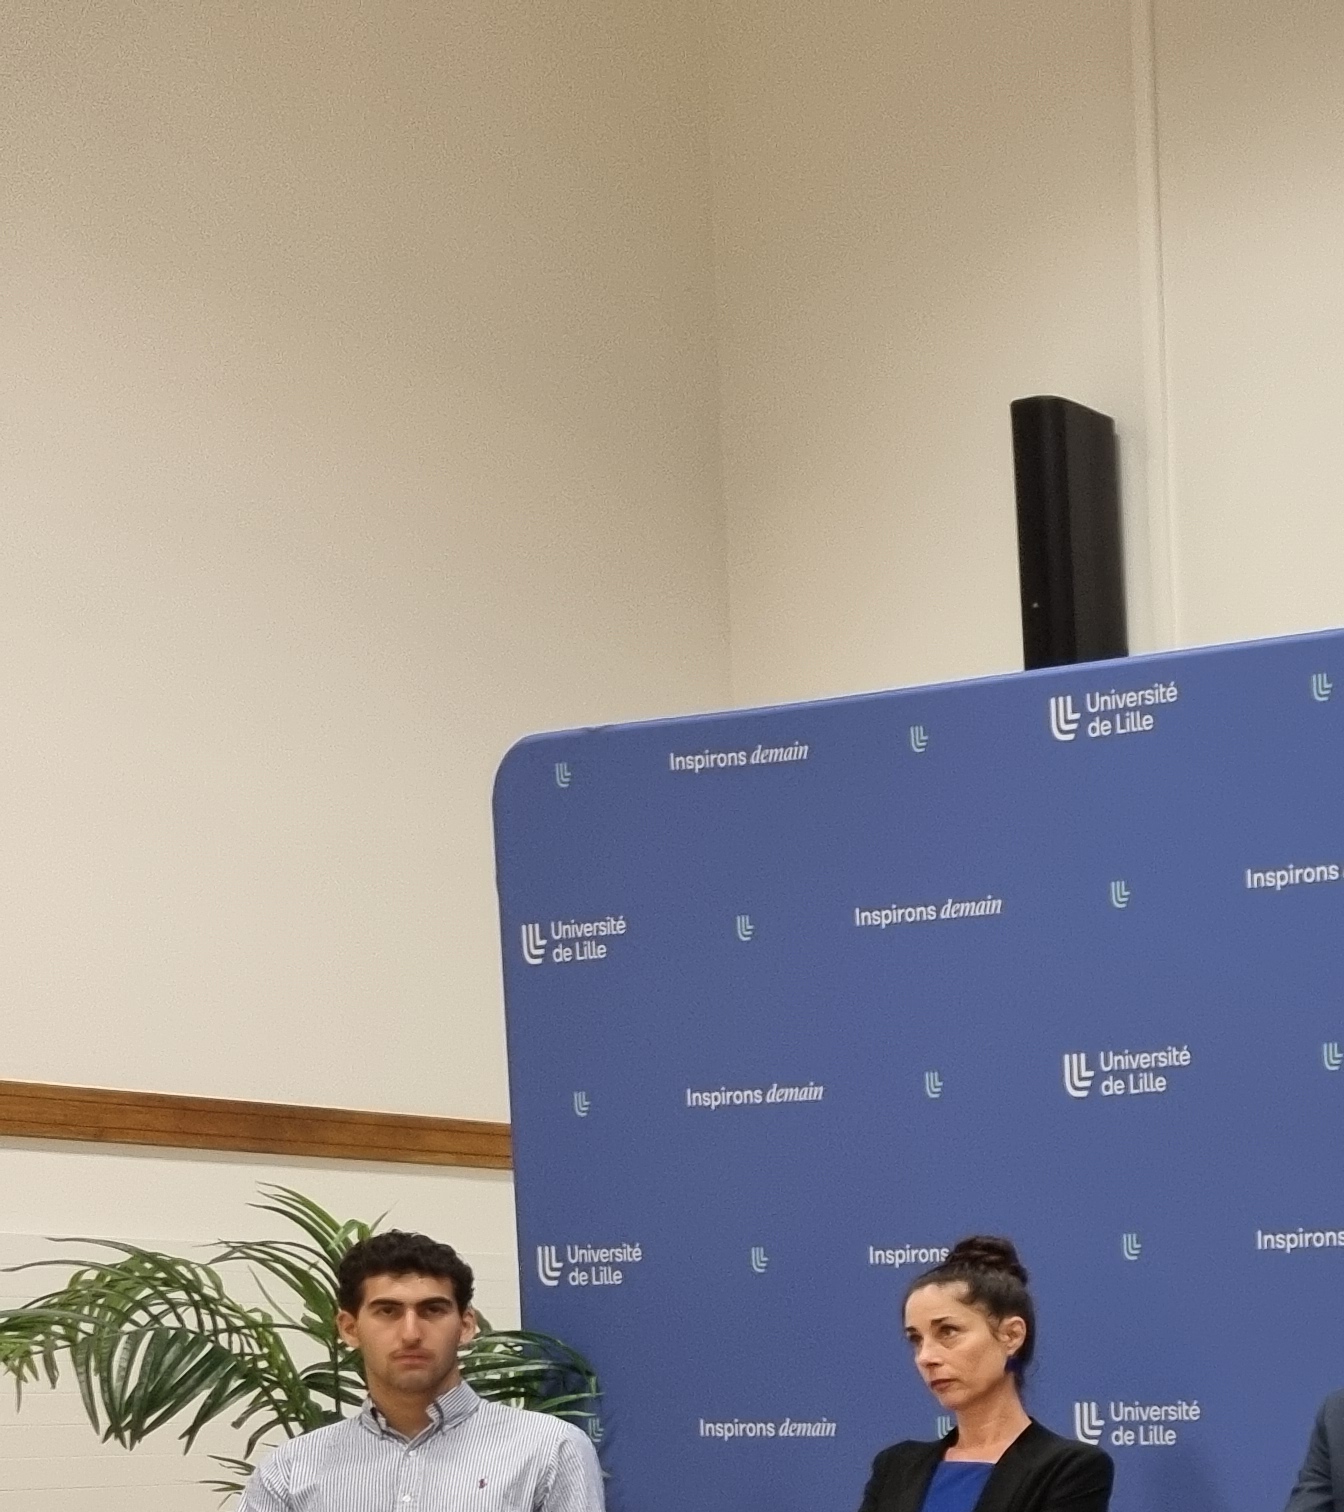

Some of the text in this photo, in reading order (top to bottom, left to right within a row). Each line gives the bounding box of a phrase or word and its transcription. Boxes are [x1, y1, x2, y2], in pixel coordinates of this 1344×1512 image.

[1085, 680, 1179, 713] Université
[1087, 710, 1154, 738] de Lille
[669, 740, 809, 774] Inspirons demain
[1245, 863, 1340, 891] Inspirons
[854, 894, 1003, 930] Inspirons demain
[550, 915, 627, 941] Université
[551, 939, 607, 963] de Lille
[1099, 1044, 1191, 1072] Université
[686, 1081, 824, 1111] Inspirons demain
[1100, 1071, 1167, 1096] de Lille
[566, 1242, 643, 1264] Université
[868, 1243, 950, 1269] Inspirons
[567, 1265, 623, 1286] de Lille
[1109, 1399, 1201, 1422] Université
[699, 1417, 837, 1442] Inspirons demain
[1110, 1424, 1177, 1446] de Lille
